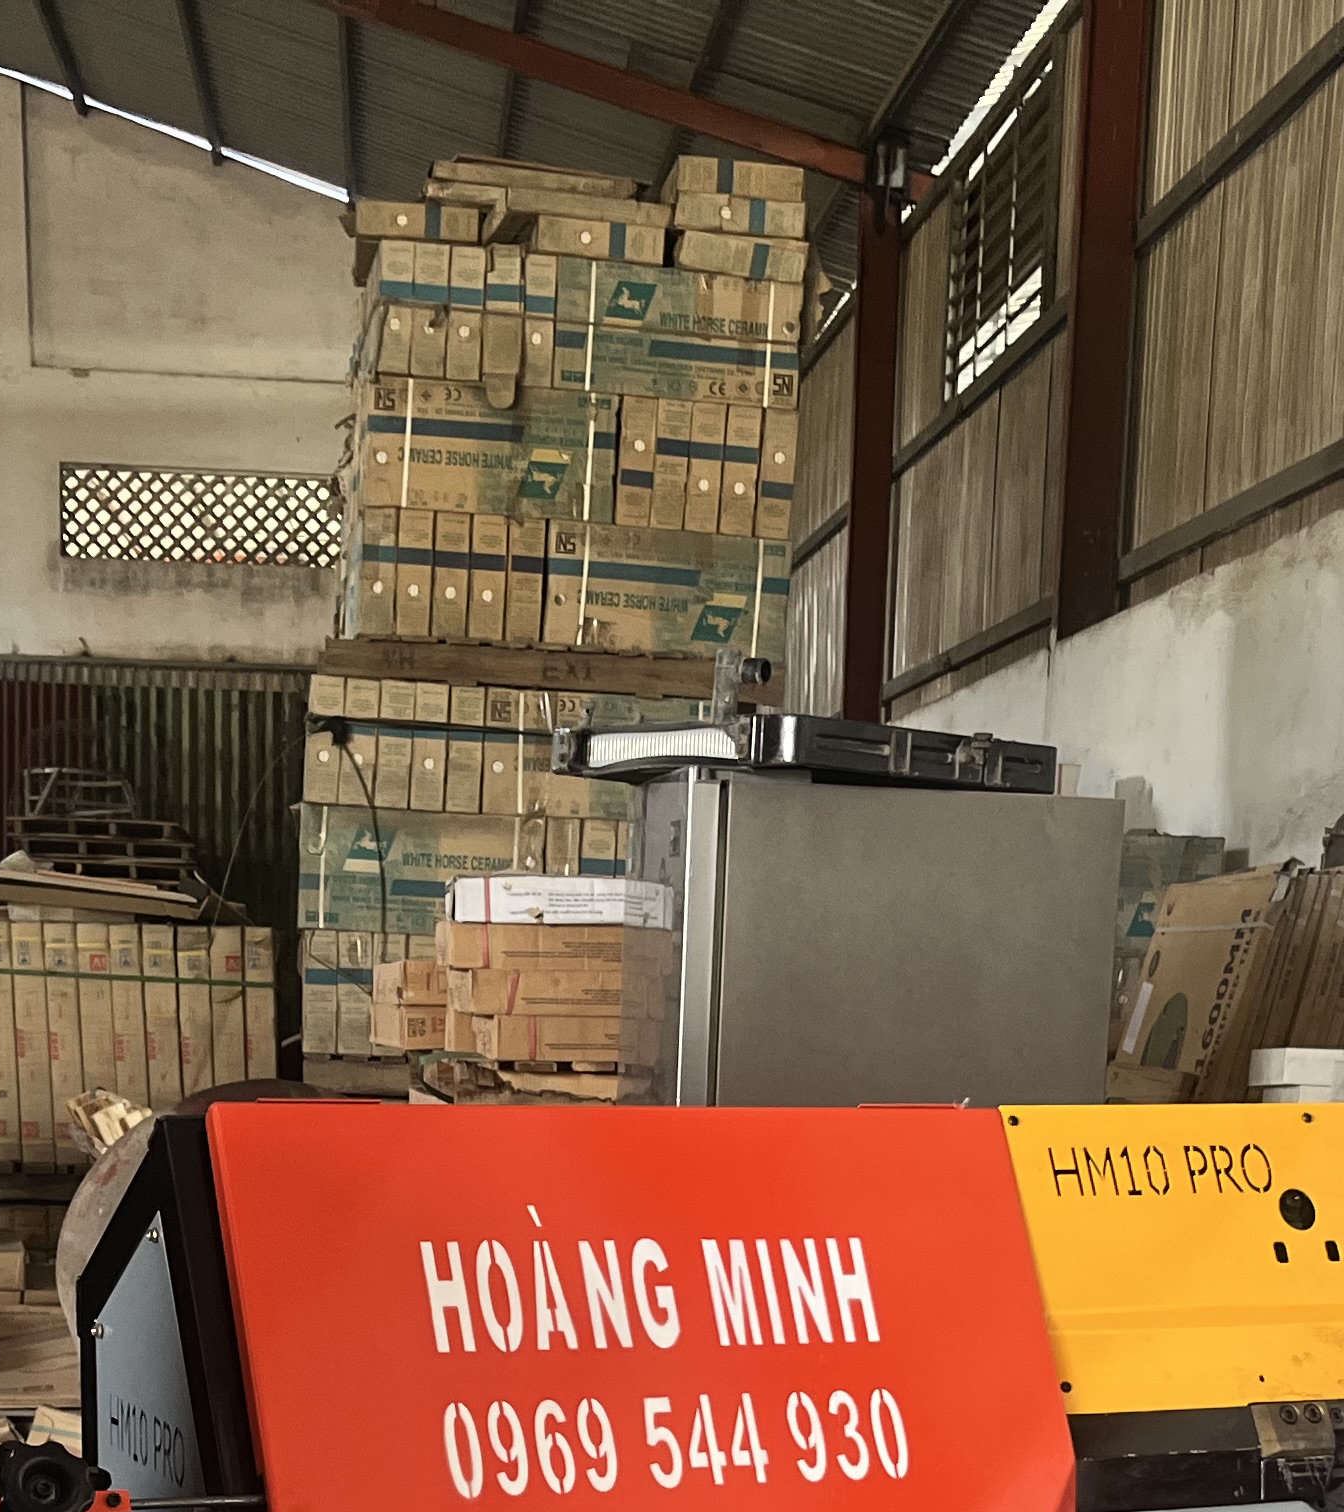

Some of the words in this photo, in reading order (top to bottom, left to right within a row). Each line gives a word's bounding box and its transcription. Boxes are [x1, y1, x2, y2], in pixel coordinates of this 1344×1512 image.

[1048, 1146, 1171, 1197] HM10
[1183, 1143, 1273, 1194] PRO
[419, 1204, 682, 1354] HOÀNG
[701, 1237, 882, 1348] MINH
[109, 1394, 149, 1467] HM10
[153, 1415, 186, 1488] PRO
[443, 1397, 619, 1499] 0969
[643, 1391, 770, 1490] 544
[786, 1388, 910, 1483] 930
